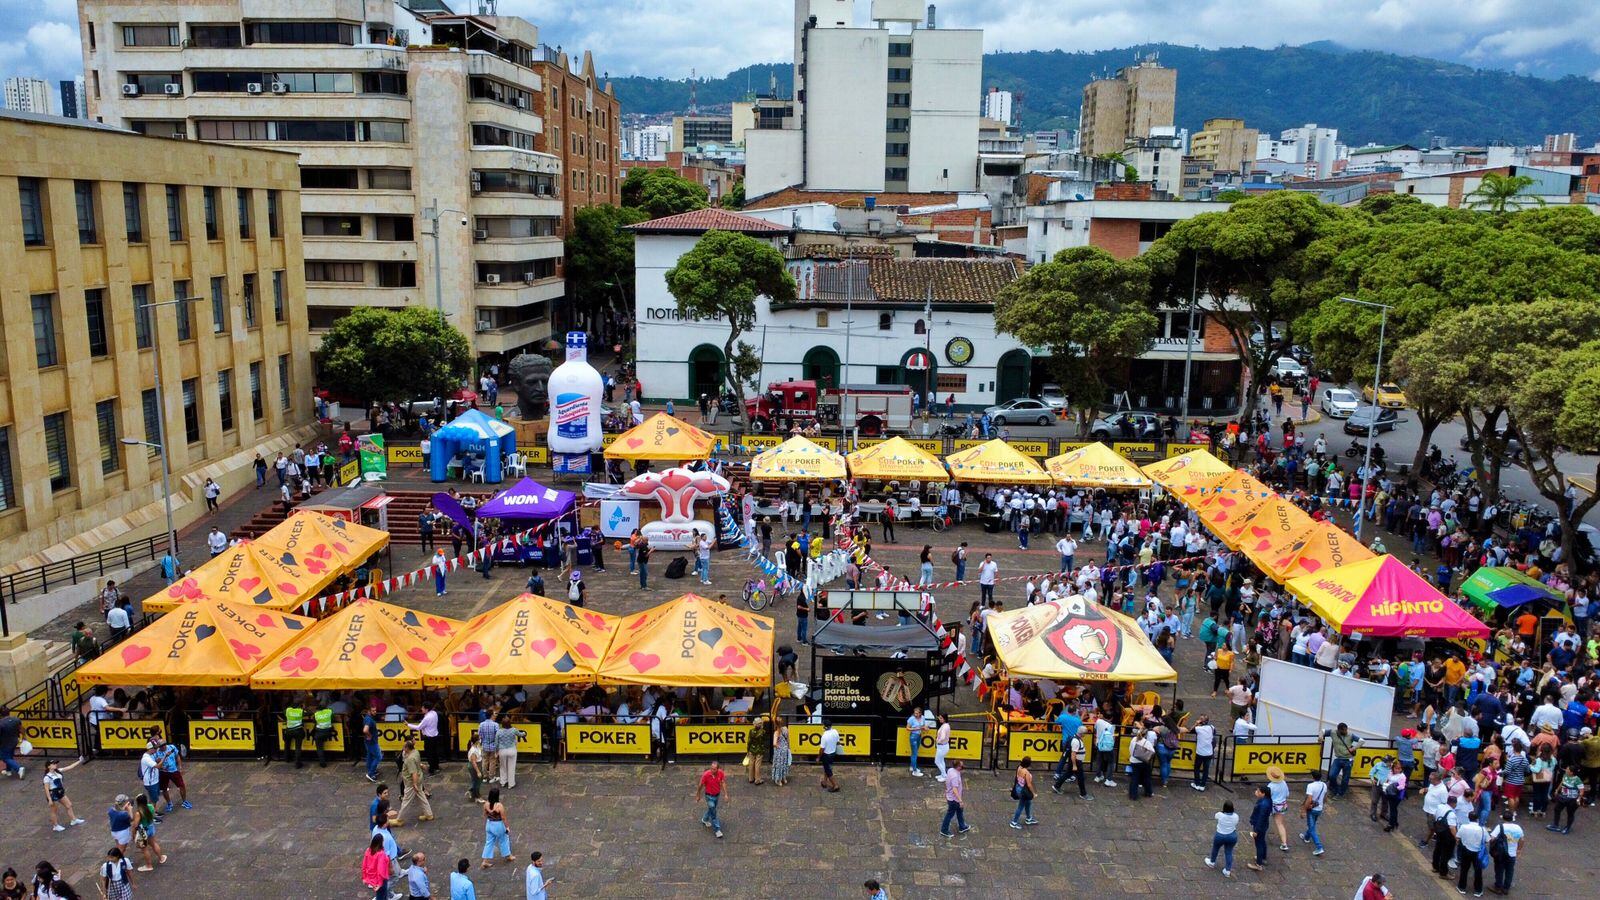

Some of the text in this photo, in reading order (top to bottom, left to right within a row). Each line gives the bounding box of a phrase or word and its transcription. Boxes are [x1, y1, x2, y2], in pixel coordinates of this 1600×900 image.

[646, 307, 698, 321] NOTAIA
[655, 420, 665, 446] POKER
[602, 437, 617, 445] KER
[748, 439, 777, 447] POKER
[395, 449, 423, 458] POKE
[517, 450, 540, 458] OKER
[1241, 478, 1255, 501] OKER
[503, 494, 539, 506] WOM
[1277, 505, 1291, 531] OKER
[286, 519, 305, 550] OKER
[316, 515, 354, 543] POKER
[259, 548, 301, 578] POKER
[219, 553, 245, 592] POKER
[217, 603, 266, 638] POKER
[168, 610, 198, 659] POKER
[339, 614, 365, 661] POKER
[510, 609, 530, 656] POKER
[681, 610, 697, 658] POKER
[1010, 616, 1034, 648] POKER
[825, 688, 845, 696] para
[16, 699, 46, 719] OKER
[25, 726, 73, 739] OKER
[195, 727, 251, 740] POKER
[377, 728, 424, 742] POKE
[580, 731, 636, 745] POKER
[689, 731, 746, 744] POKER
[799, 733, 856, 746] POER
[920, 735, 968, 750] OER
[1023, 738, 1063, 752] POK
[1248, 751, 1306, 765] POKER
